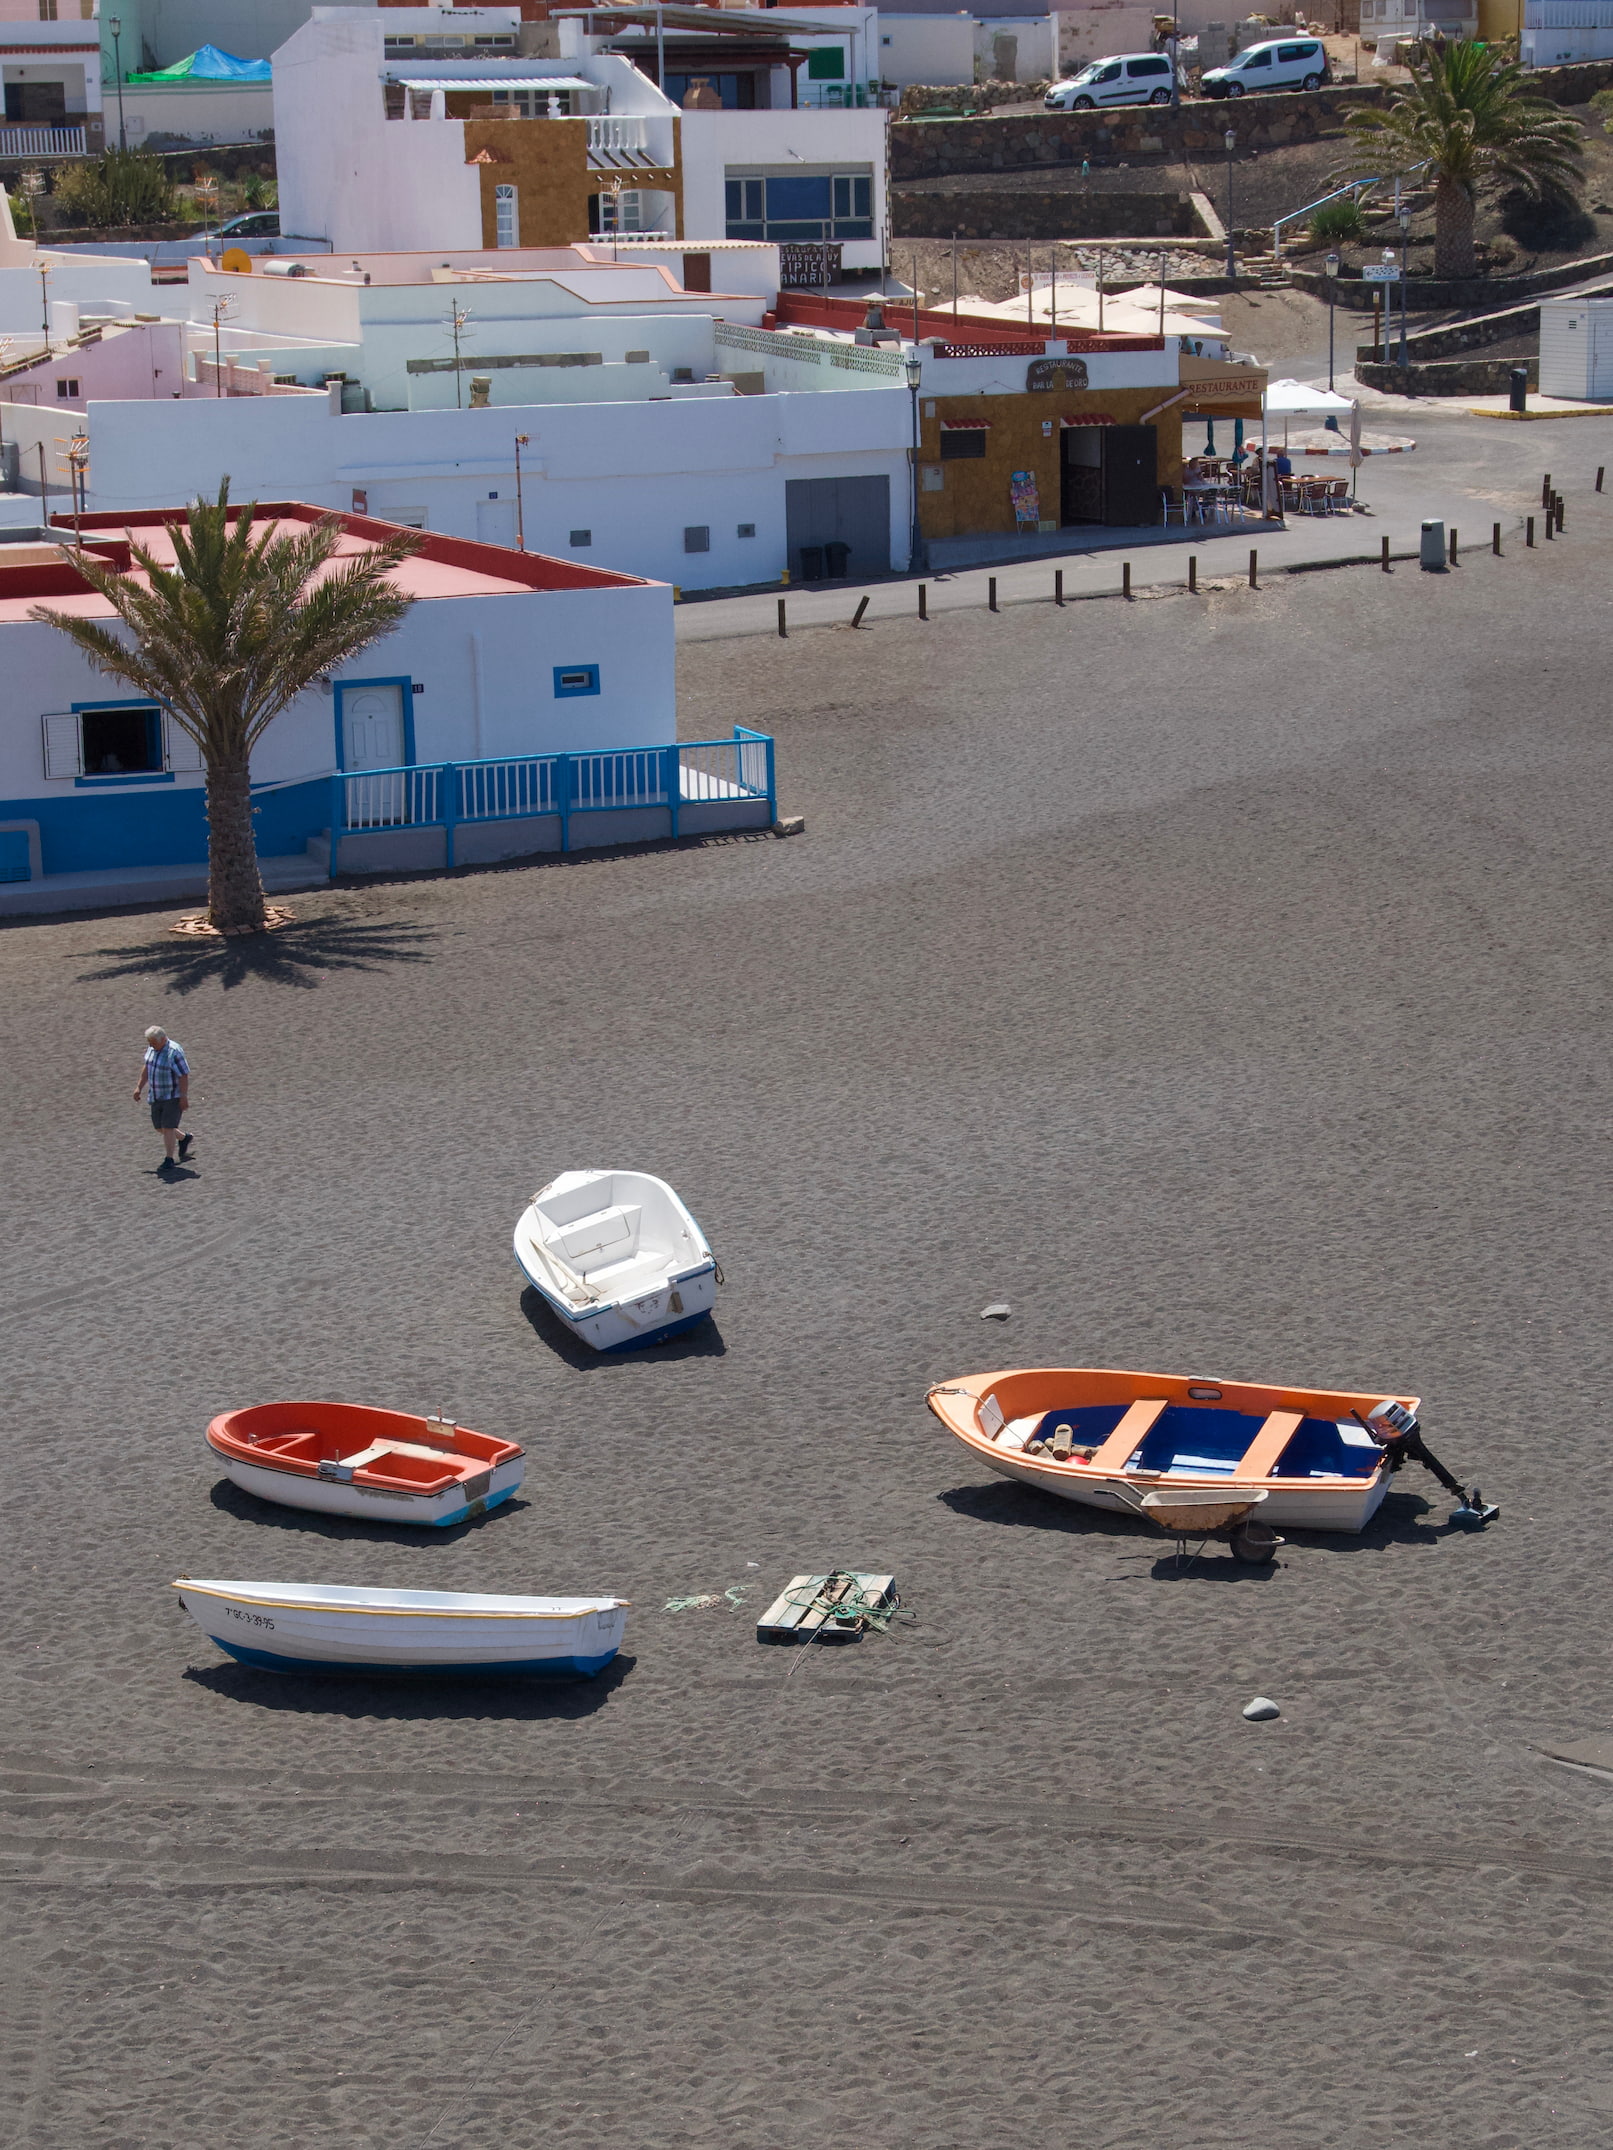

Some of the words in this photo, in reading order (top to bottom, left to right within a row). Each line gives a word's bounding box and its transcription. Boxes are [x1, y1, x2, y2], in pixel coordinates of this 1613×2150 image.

[816, 253, 839, 261] AUY
[1035, 360, 1083, 374] RESTAURANTE
[1032, 381, 1045, 389] BAR
[1046, 380, 1054, 389] LA
[1189, 380, 1258, 393] RESTAURANTE
